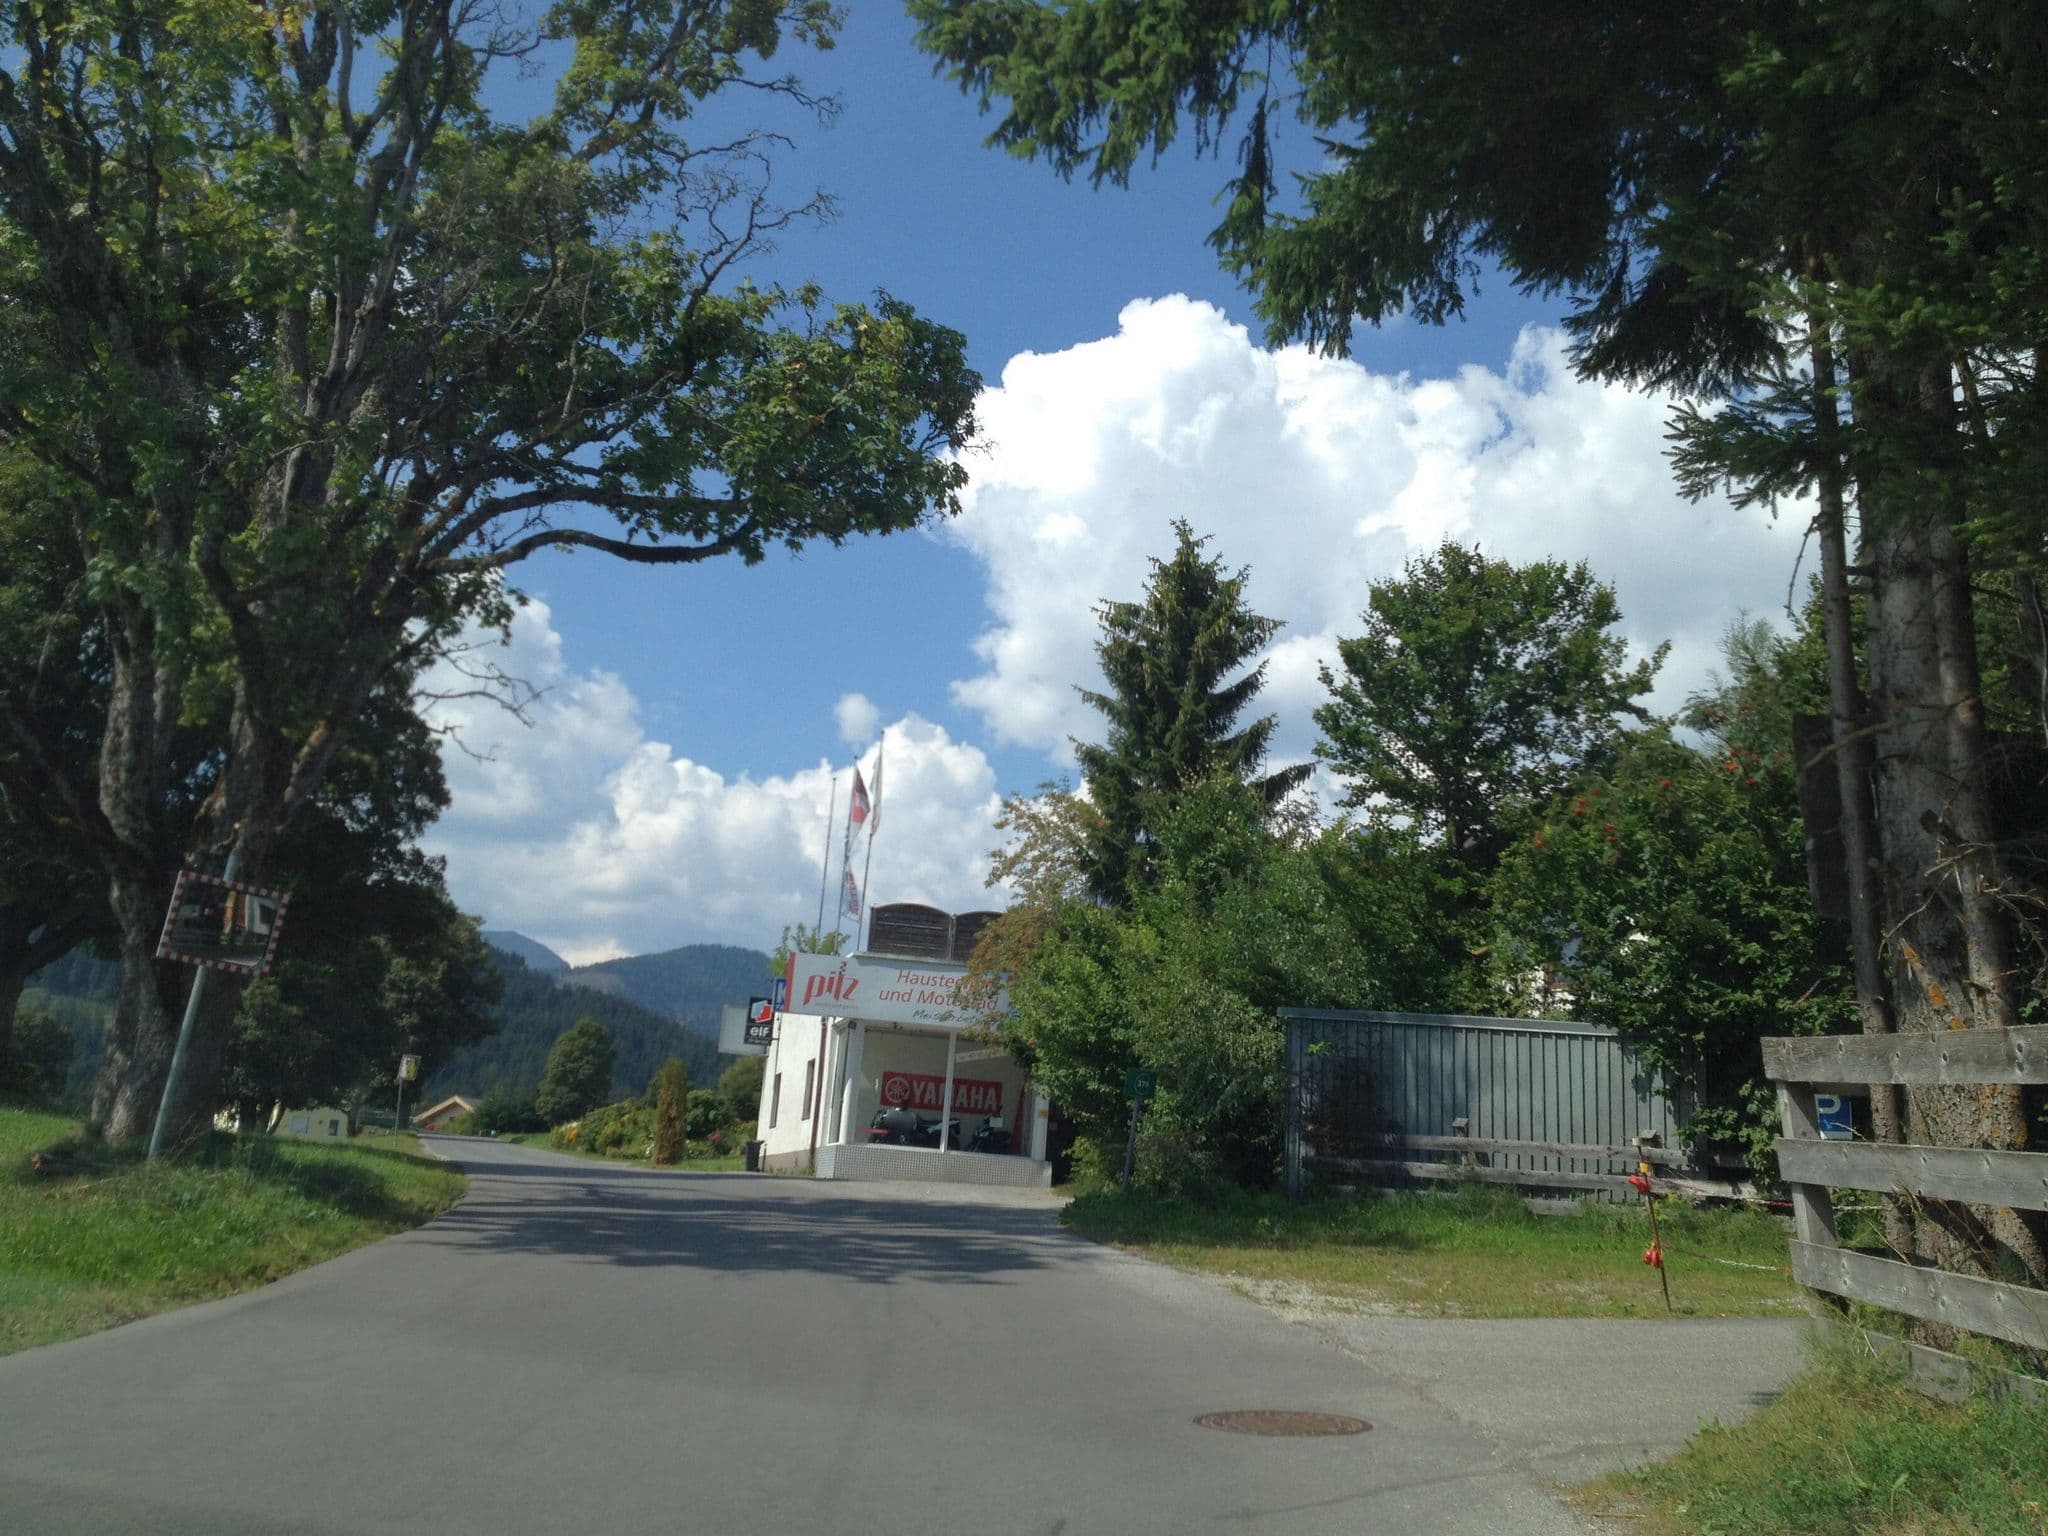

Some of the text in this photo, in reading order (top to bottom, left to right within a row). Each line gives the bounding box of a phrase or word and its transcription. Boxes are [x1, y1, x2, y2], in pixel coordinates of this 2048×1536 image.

[803, 969, 860, 1005] pilz
[879, 988, 914, 1003] und
[750, 1026, 769, 1036] elf
[1813, 1093, 1841, 1122] P
